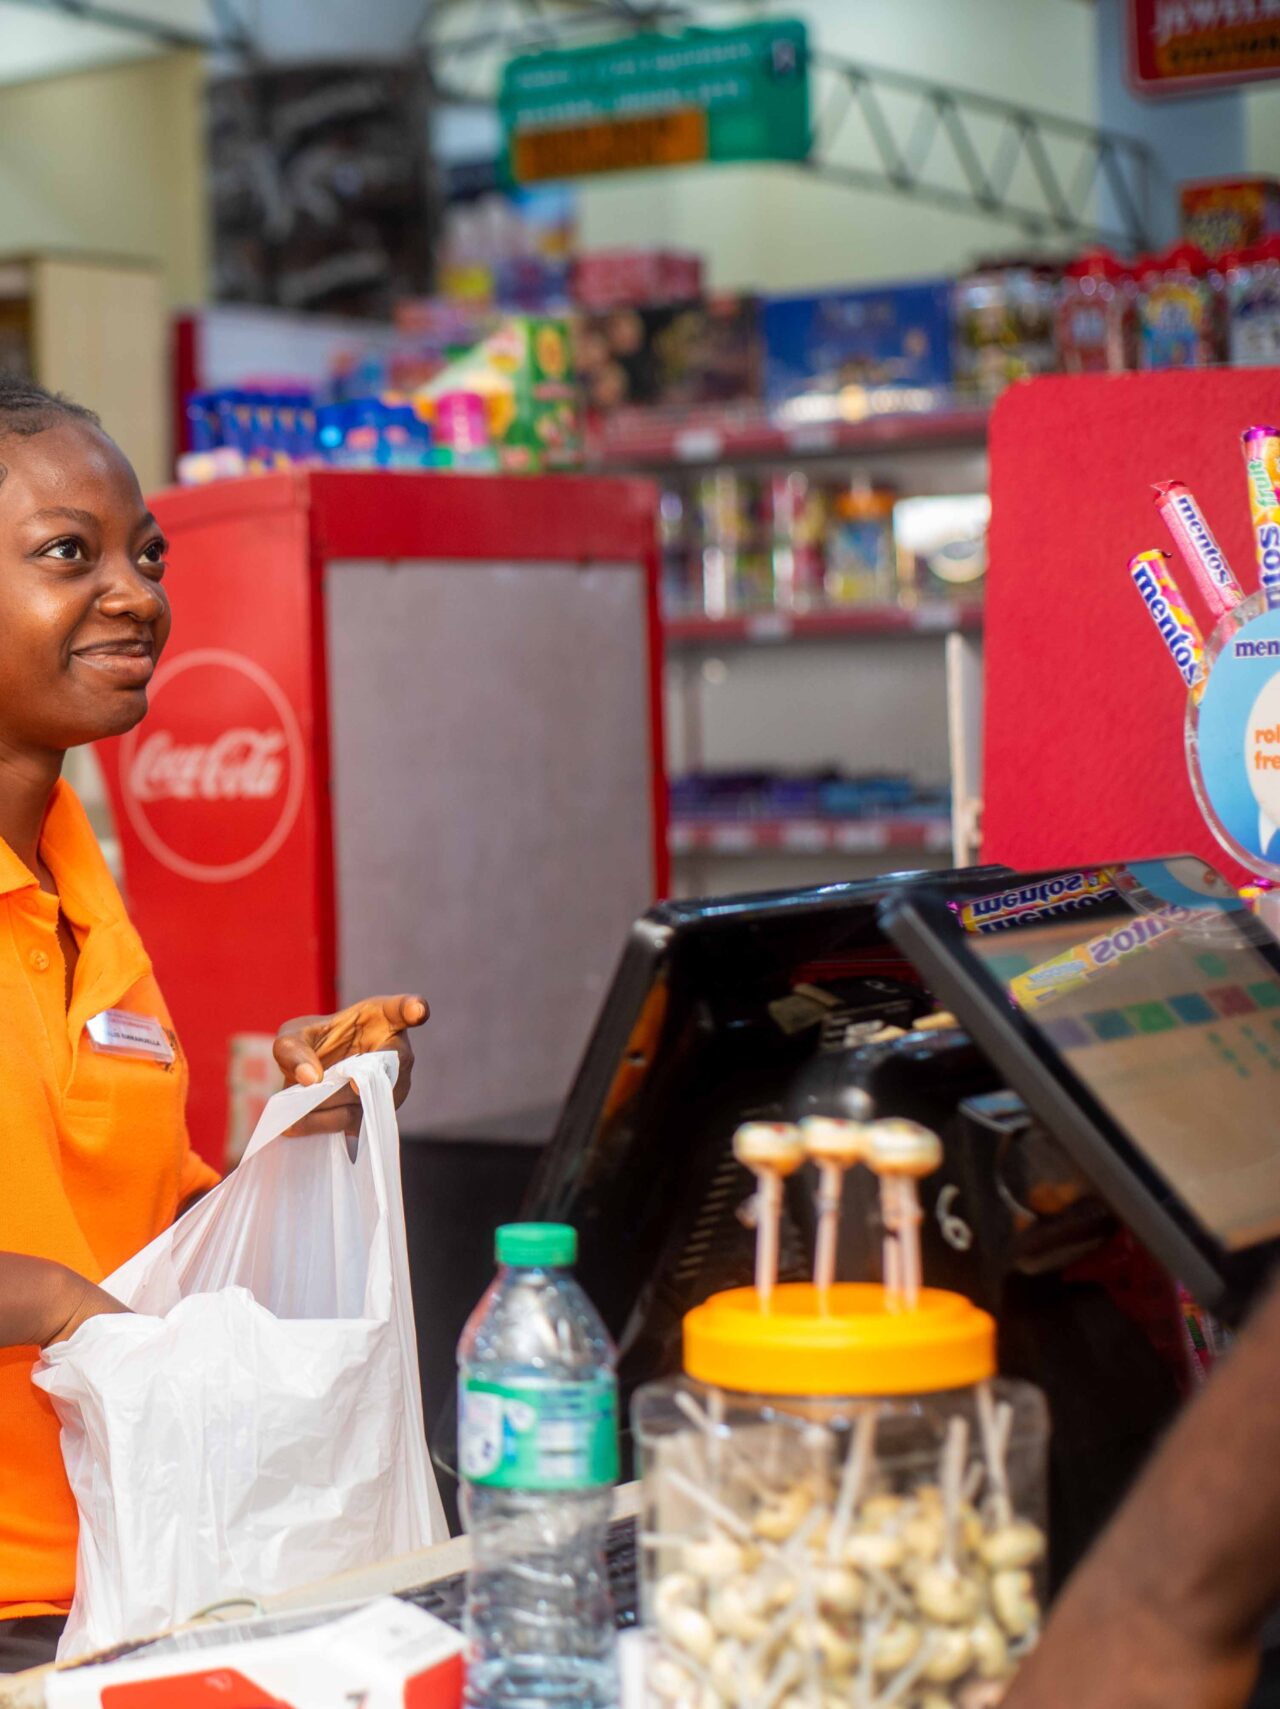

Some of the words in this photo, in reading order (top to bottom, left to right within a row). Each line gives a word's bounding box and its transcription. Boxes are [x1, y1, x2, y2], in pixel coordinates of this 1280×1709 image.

[1178, 497, 1229, 585] mentos
[1133, 566, 1198, 686] mentos
[131, 729, 284, 801] Coca-Cola
[936, 1184, 972, 1250] 6
